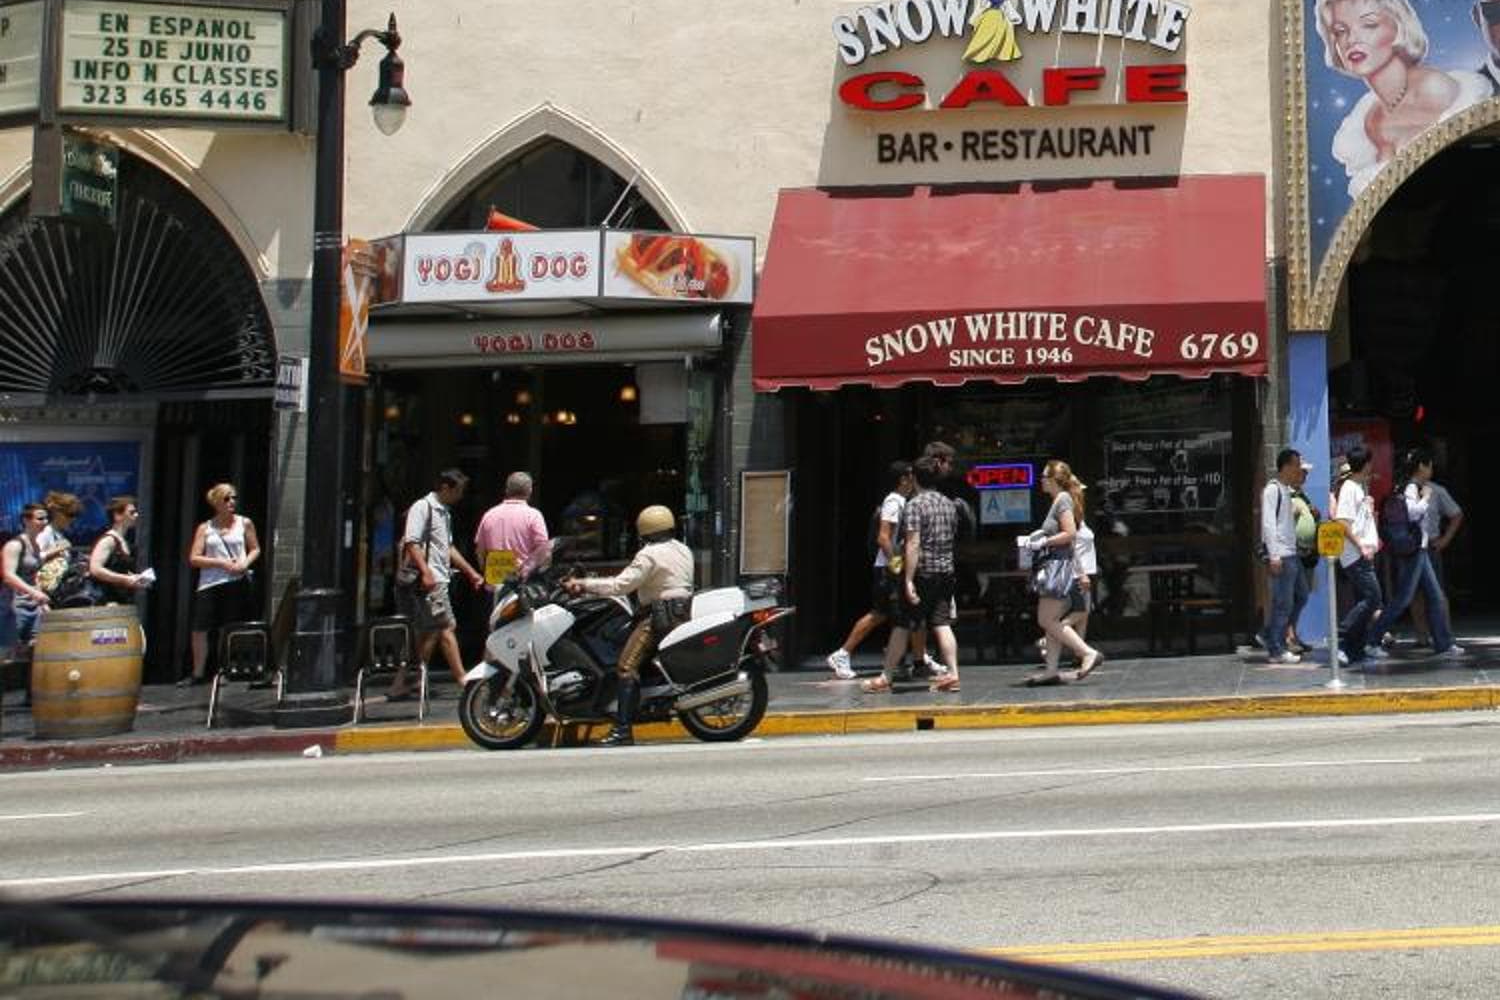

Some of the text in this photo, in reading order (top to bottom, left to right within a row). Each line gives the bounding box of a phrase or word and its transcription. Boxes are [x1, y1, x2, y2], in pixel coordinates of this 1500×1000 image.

[100, 12, 256, 39] EN ESPANOL
[103, 37, 251, 63] 25 DE JUNIO
[73, 60, 279, 89] INFO N CLASSES
[838, 63, 1189, 112] CAFE
[82, 85, 267, 110] 323 465 4446
[877, 124, 1156, 164] BAR RESTAURANT
[416, 253, 589, 283] YOGI DOG
[474, 331, 595, 353] YOGI DOG
[865, 311, 1259, 367] SNOW WHITE CAFE 6769
[949, 346, 1074, 367] SINCE 1946
[966, 469, 1026, 487] OPEN
